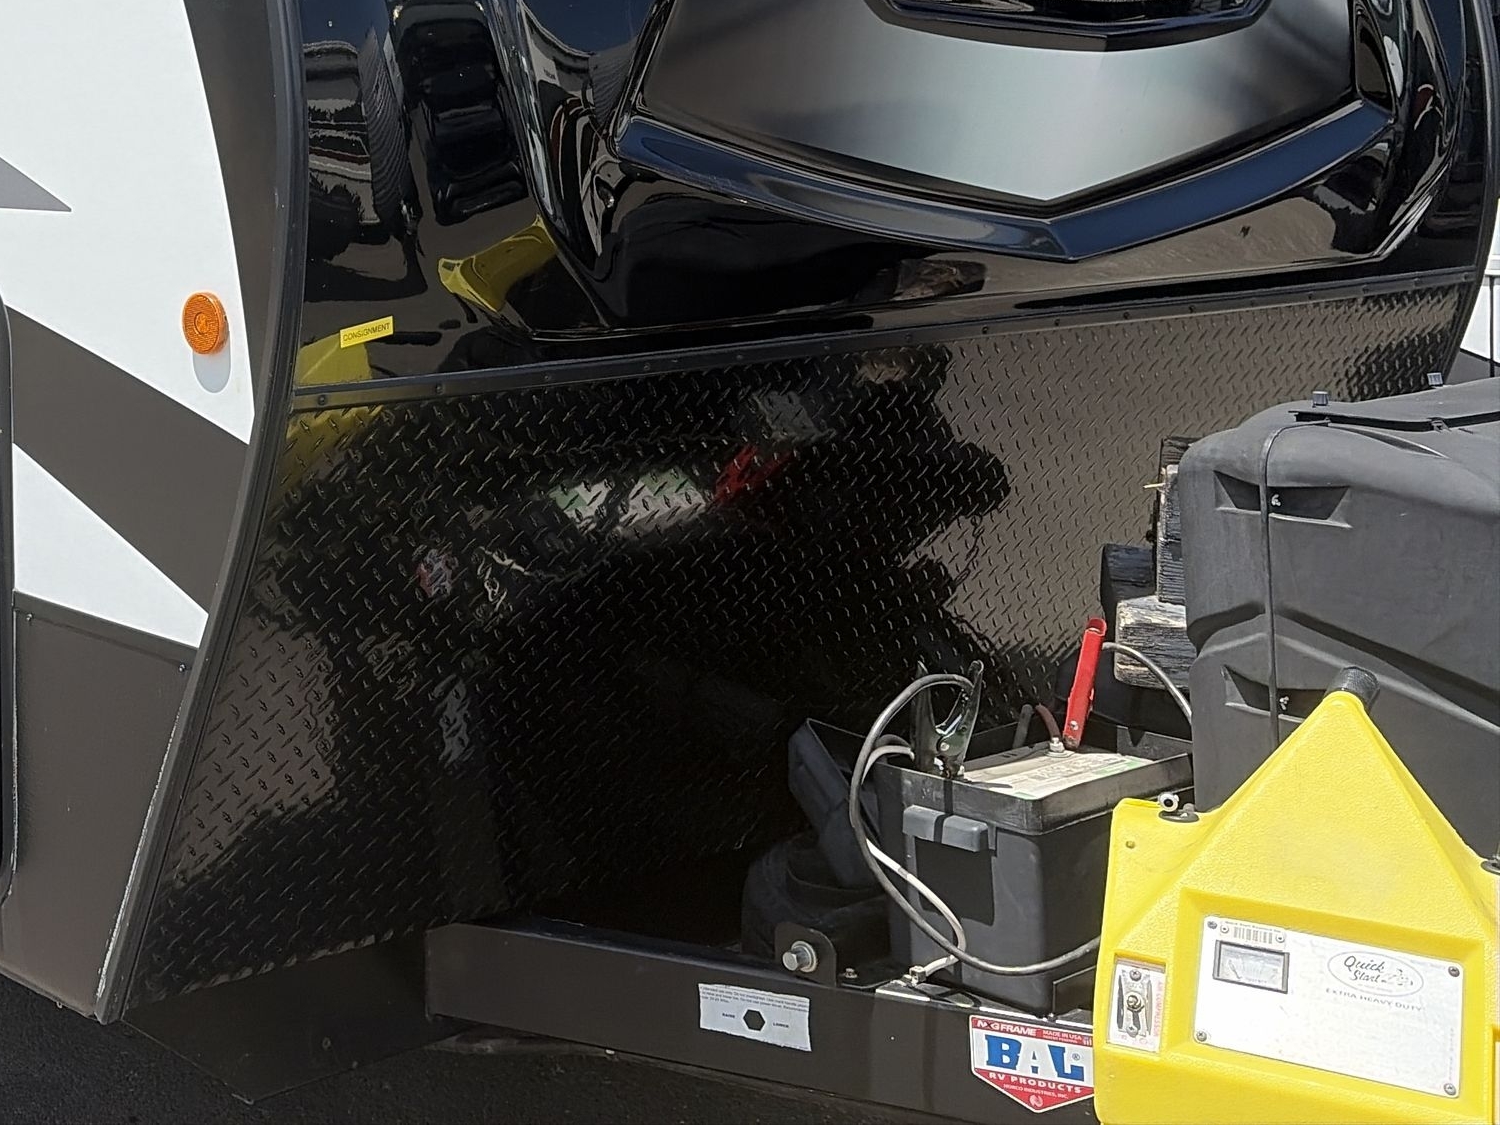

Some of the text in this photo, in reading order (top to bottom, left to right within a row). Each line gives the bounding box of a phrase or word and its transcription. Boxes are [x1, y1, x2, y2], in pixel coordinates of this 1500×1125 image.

[343, 322, 391, 342] CONSIGNMENT
[1343, 955, 1385, 974] Quick
[1349, 969, 1381, 983] Start
[1325, 987, 1357, 999] EXTRA
[1359, 995, 1391, 1006] HEAVY
[1394, 1001, 1422, 1012] DUTY
[1000, 1024, 1038, 1036] FRAME
[989, 1072, 1081, 1093] RV PRODUCTS
